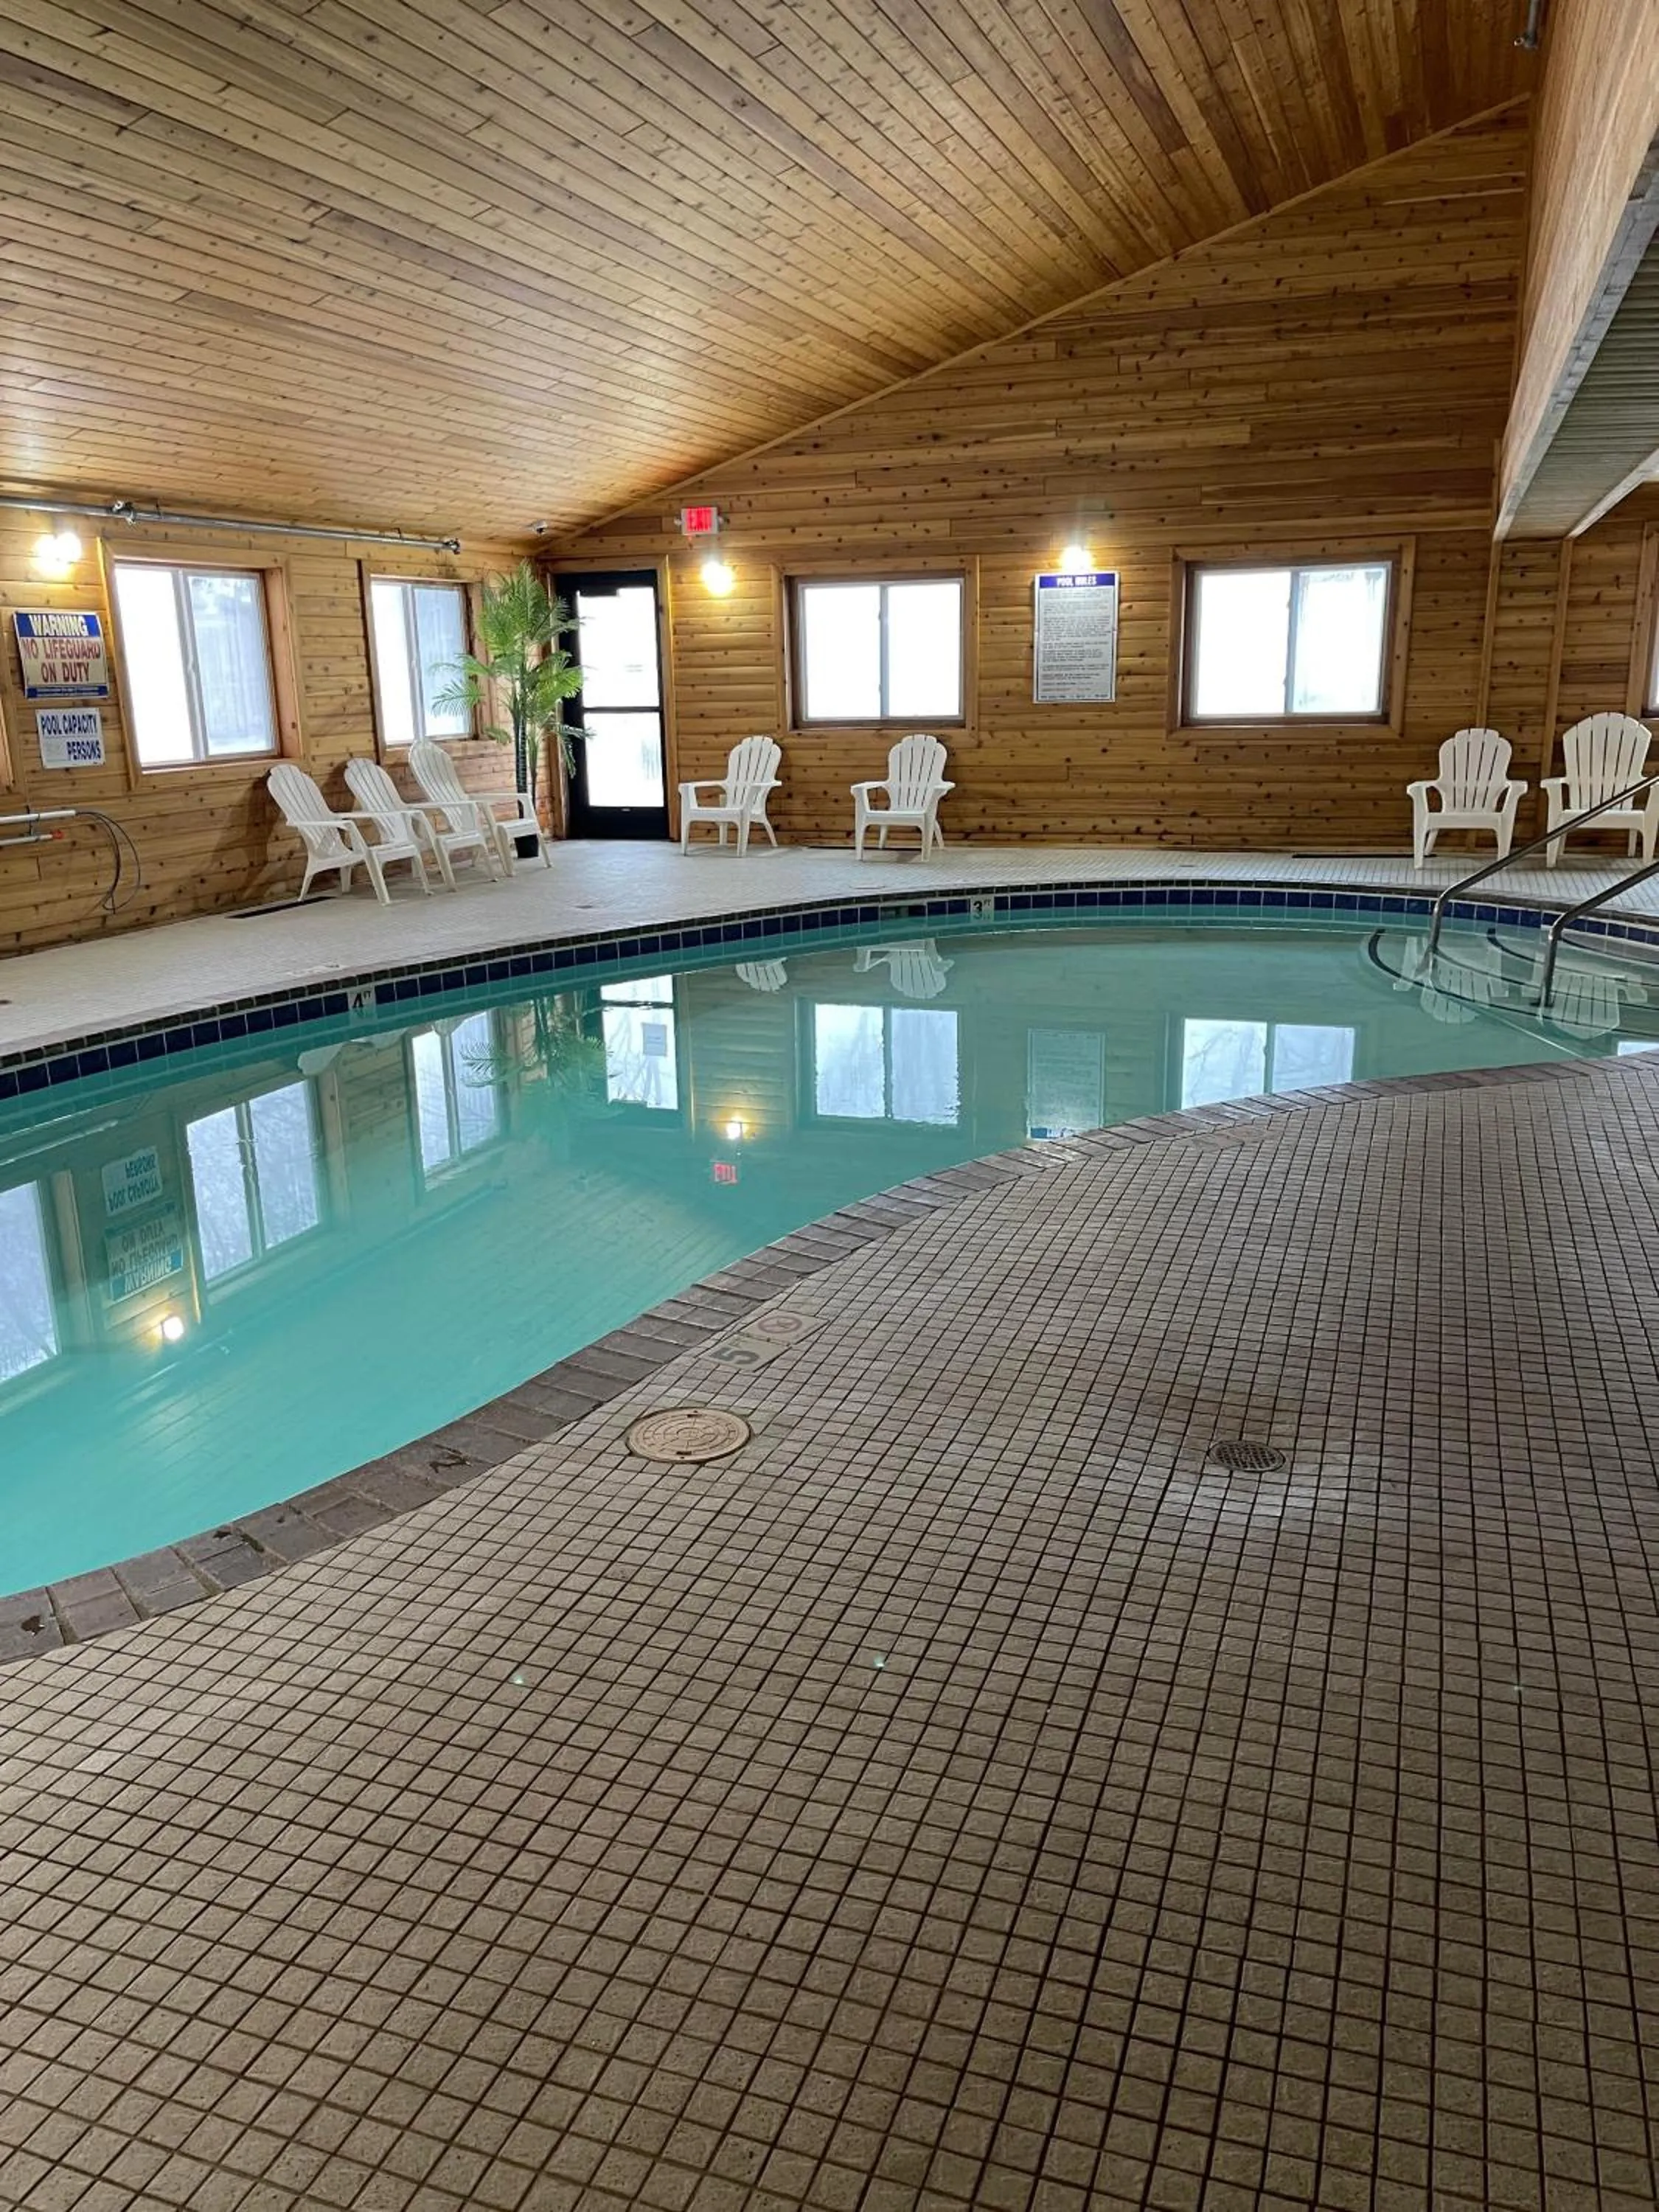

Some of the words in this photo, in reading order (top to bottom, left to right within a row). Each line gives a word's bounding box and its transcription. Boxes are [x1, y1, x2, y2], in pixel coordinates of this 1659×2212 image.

[28, 614, 89, 636] WARNING
[22, 639, 38, 659] NO
[44, 638, 100, 659] LIFEGUARD
[41, 662, 57, 682] ON
[63, 663, 89, 682] DUTY
[41, 714, 62, 735] POOL
[63, 714, 97, 734] CAPACITY
[66, 740, 101, 761] PERSONS
[973, 900, 983, 914] 3
[711, 1347, 760, 1365] 5
